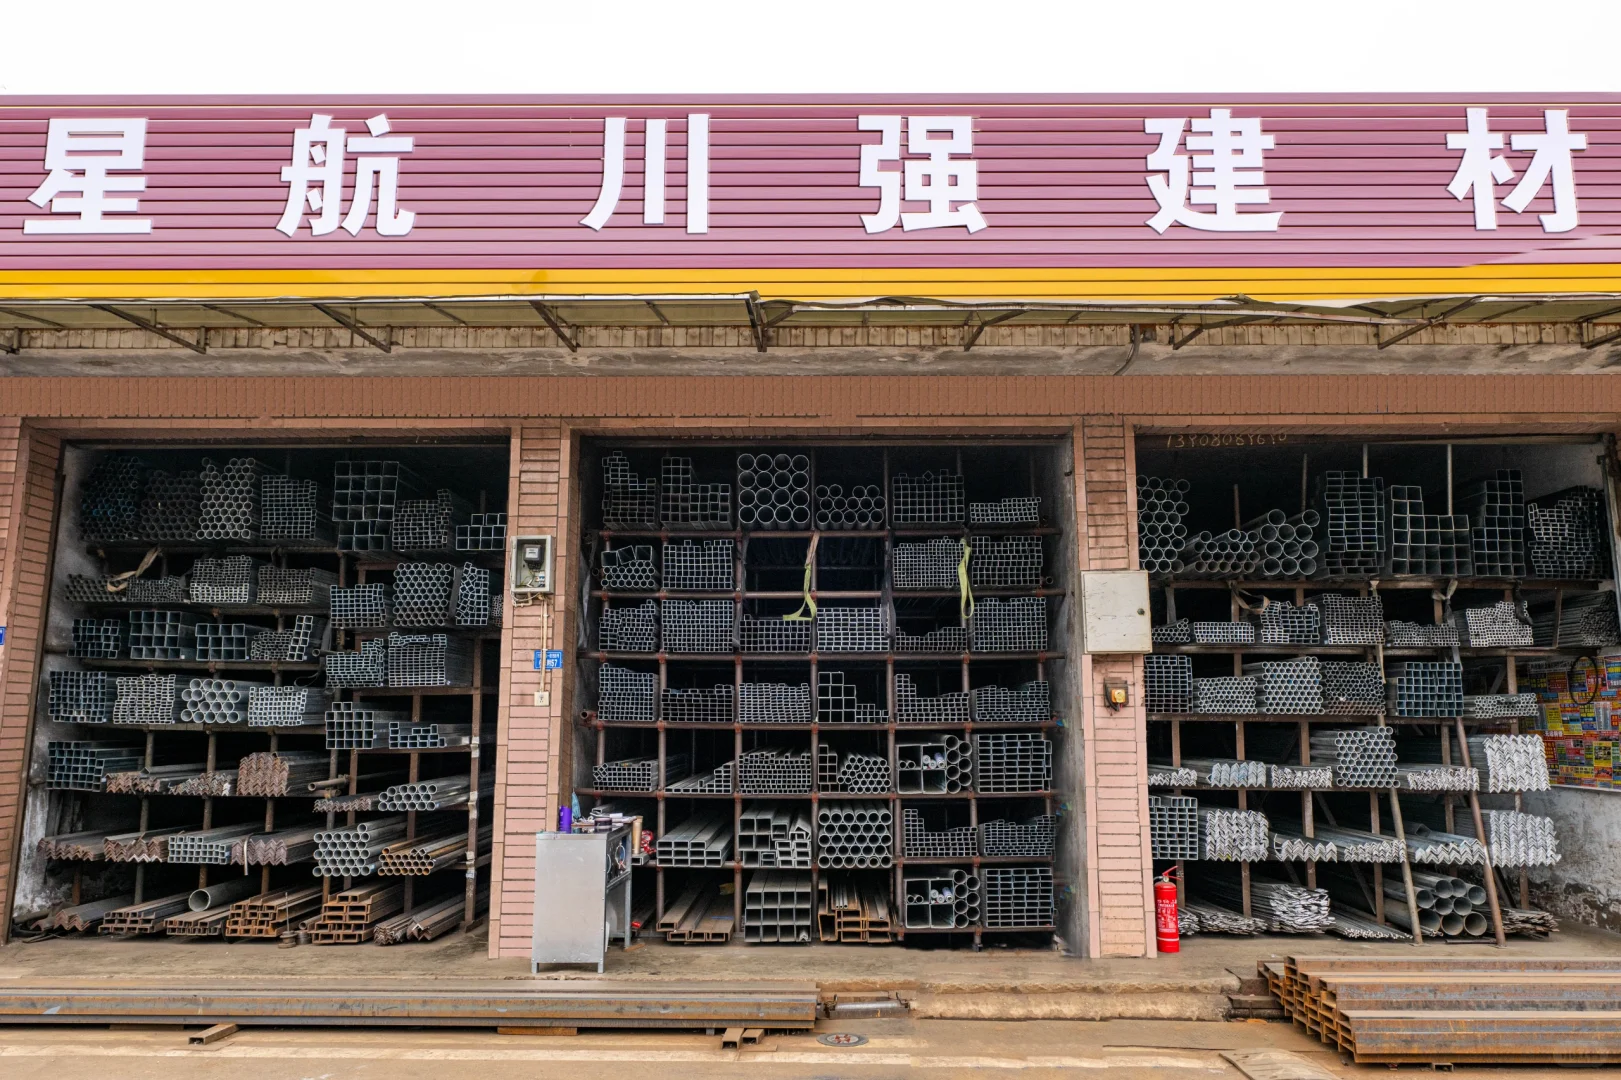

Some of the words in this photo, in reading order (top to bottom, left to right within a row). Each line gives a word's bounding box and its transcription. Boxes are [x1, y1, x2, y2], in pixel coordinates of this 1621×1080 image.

[23, 107, 1587, 236] 星航川强建材
